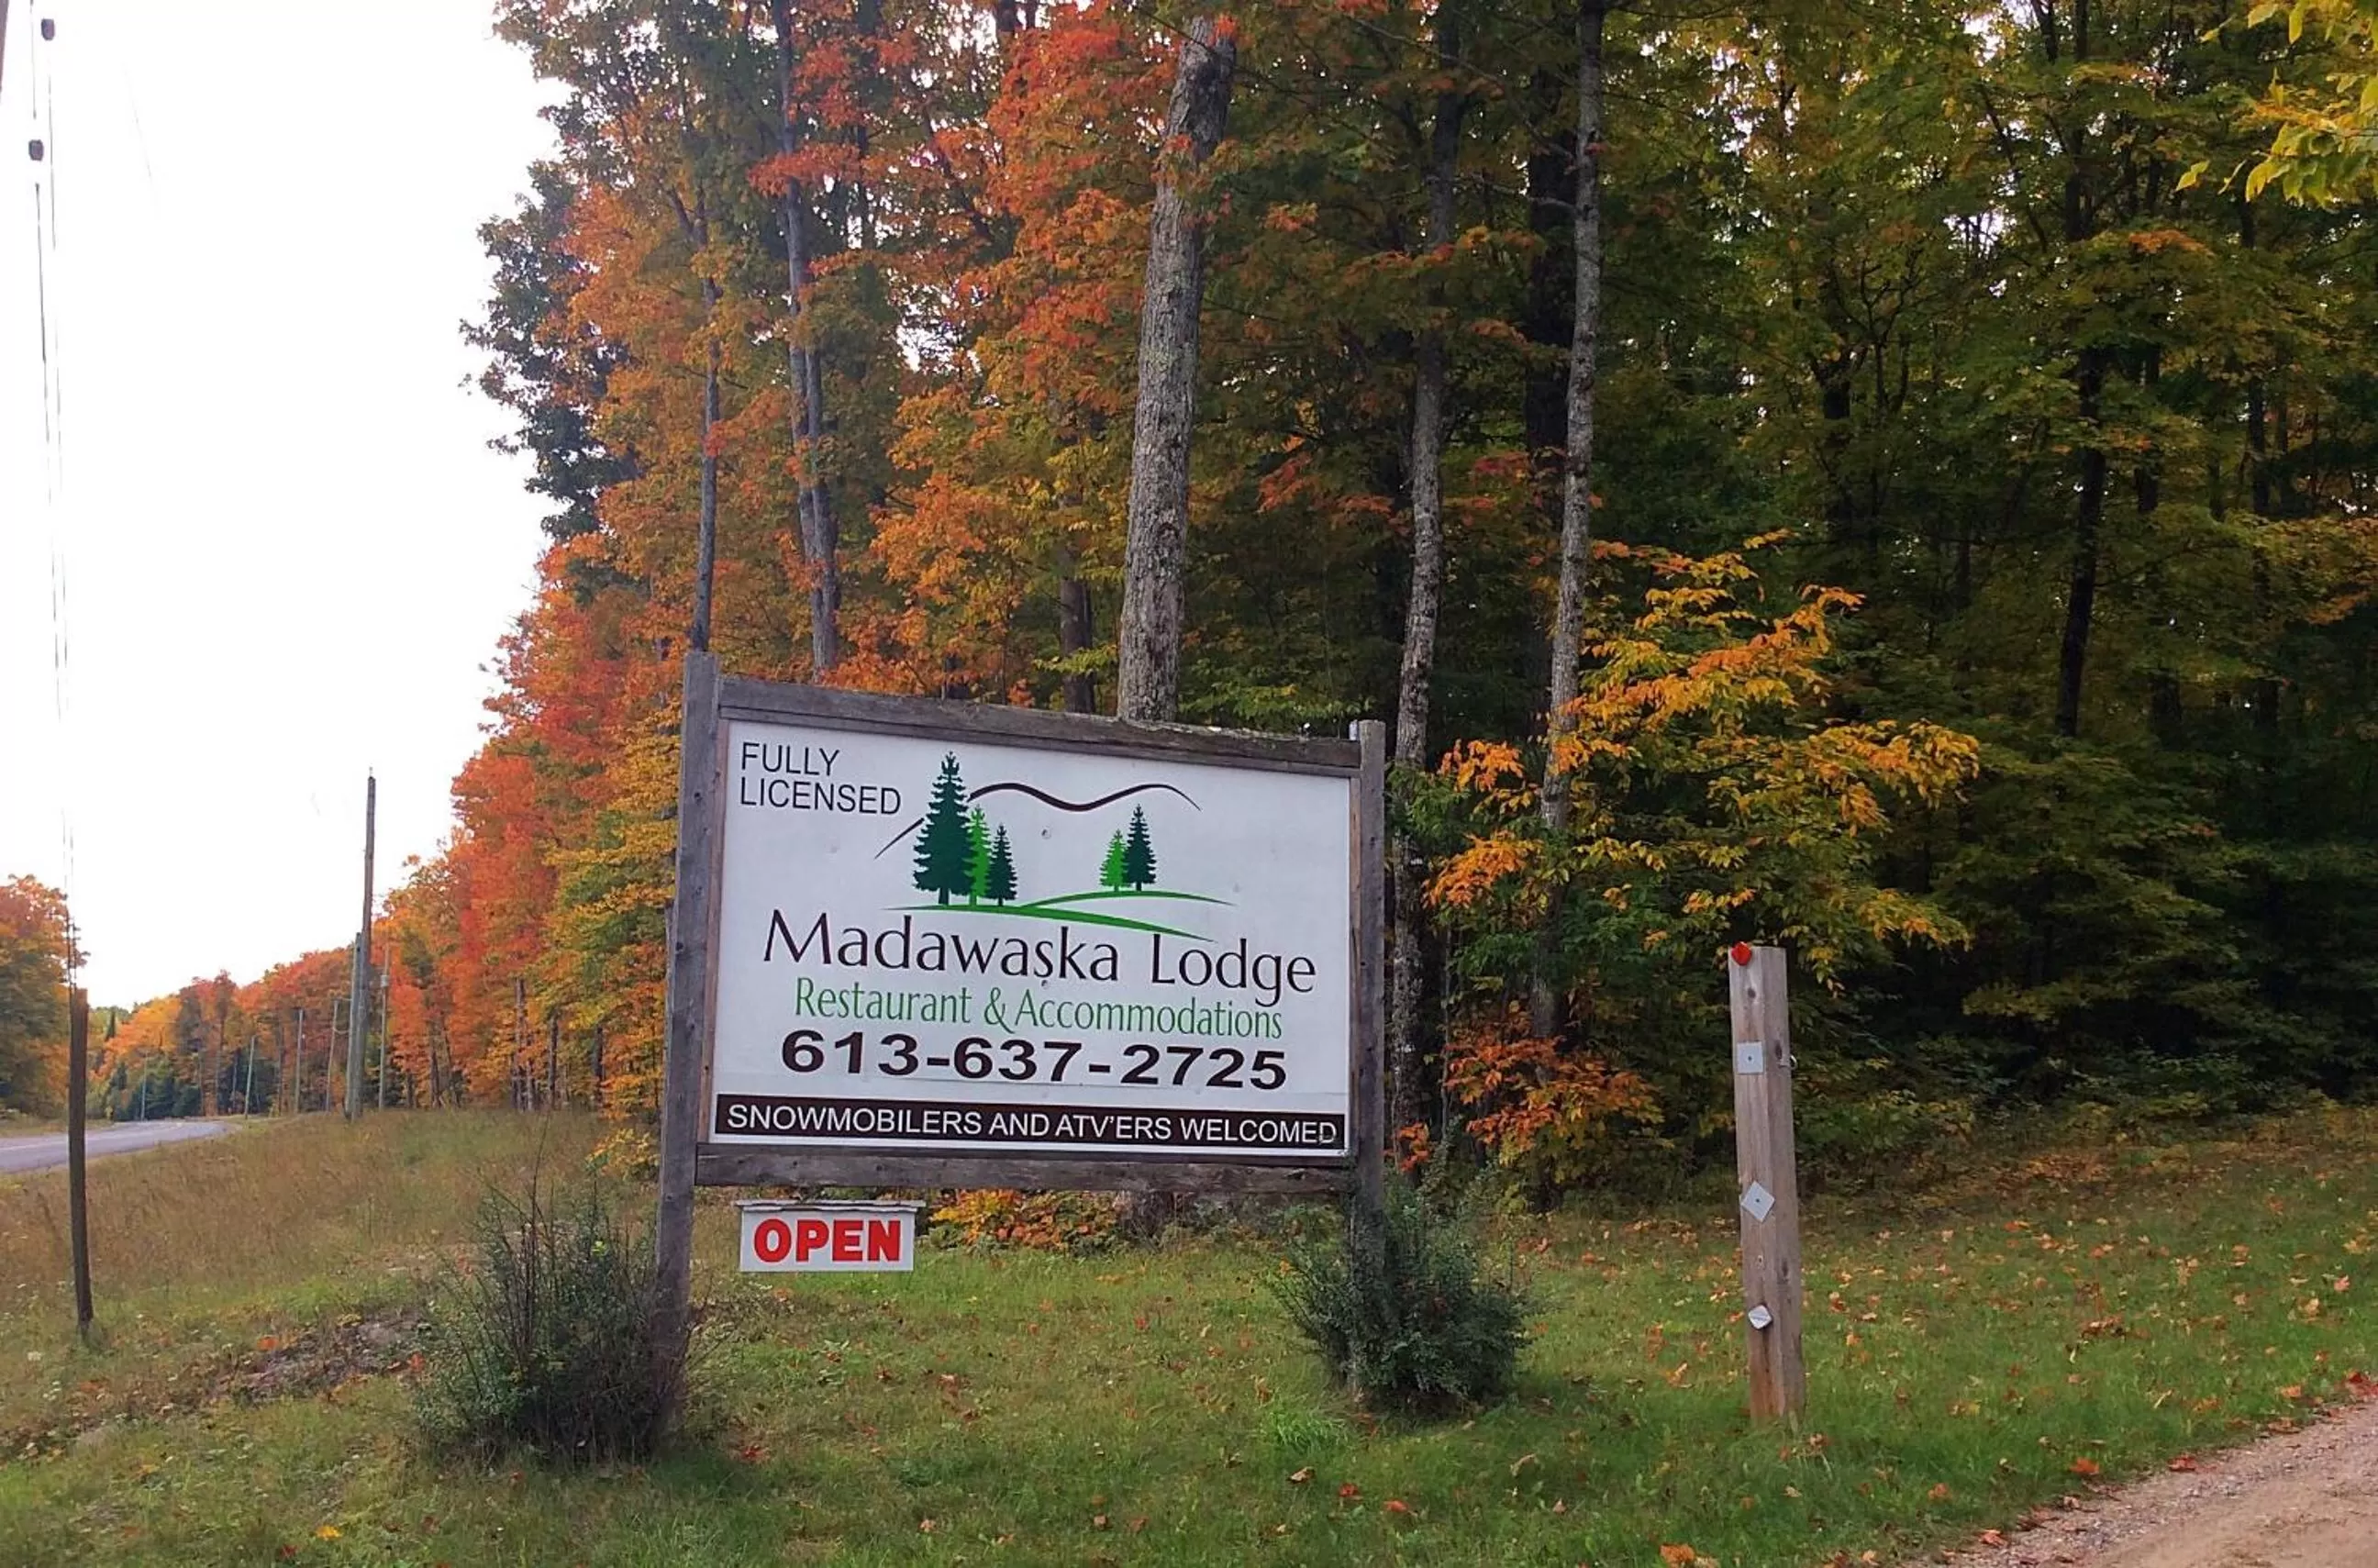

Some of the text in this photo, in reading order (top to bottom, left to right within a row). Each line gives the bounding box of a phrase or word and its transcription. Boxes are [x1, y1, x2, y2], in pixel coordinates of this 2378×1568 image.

[741, 742, 840, 776] FULLY
[739, 777, 901, 815] LICENSED
[762, 909, 1317, 1007] Madawaska Lodge
[795, 976, 972, 1024] Restaurant
[781, 1029, 1287, 1090] 613-637-2725
[727, 1104, 1337, 1144] SNOWMOBILERS AND ATV'ERS WELCOMED
[753, 1218, 901, 1263] OPEN
